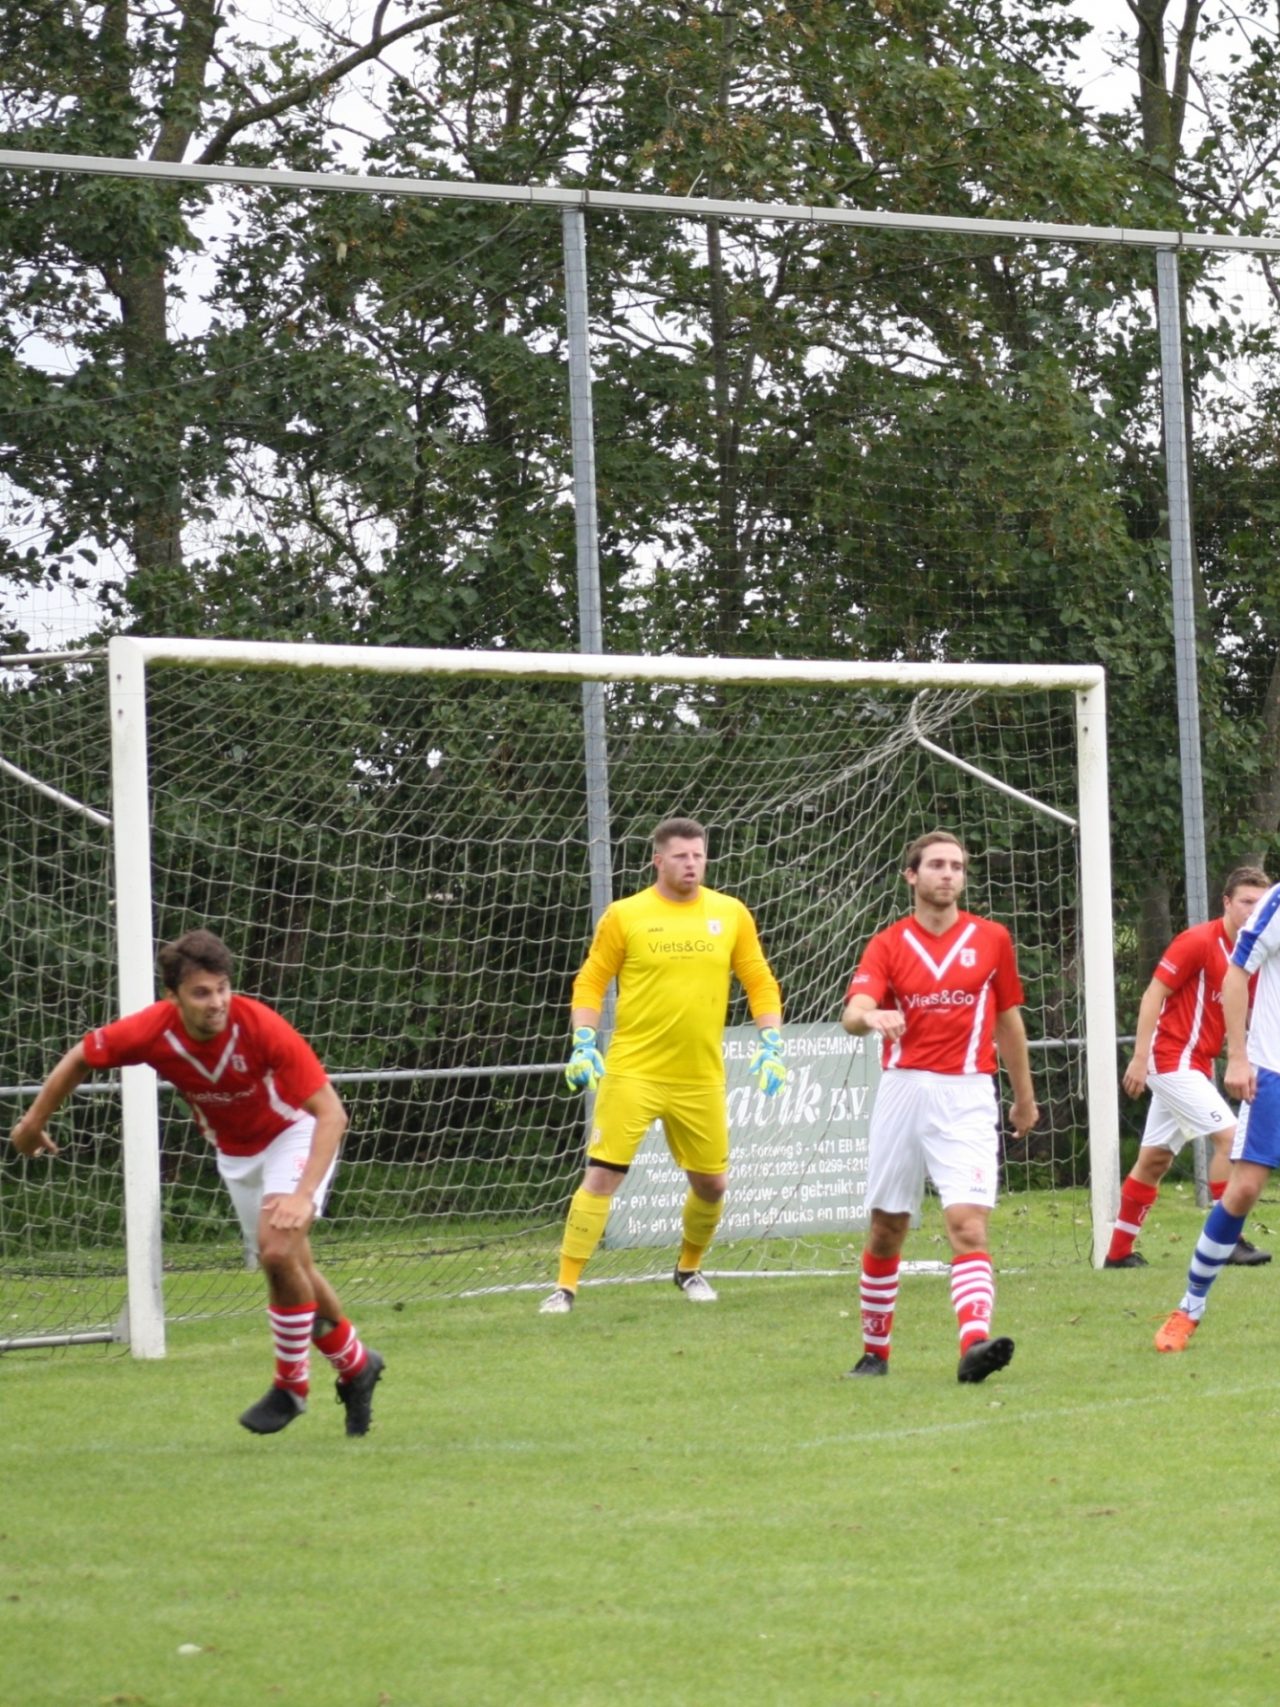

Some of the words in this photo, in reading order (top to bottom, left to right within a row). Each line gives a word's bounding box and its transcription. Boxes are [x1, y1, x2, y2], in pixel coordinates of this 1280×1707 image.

[647, 939, 715, 954] Viets&Go
[1209, 1110, 1223, 1123] 5
[800, 1178, 854, 1202] gebruikt
